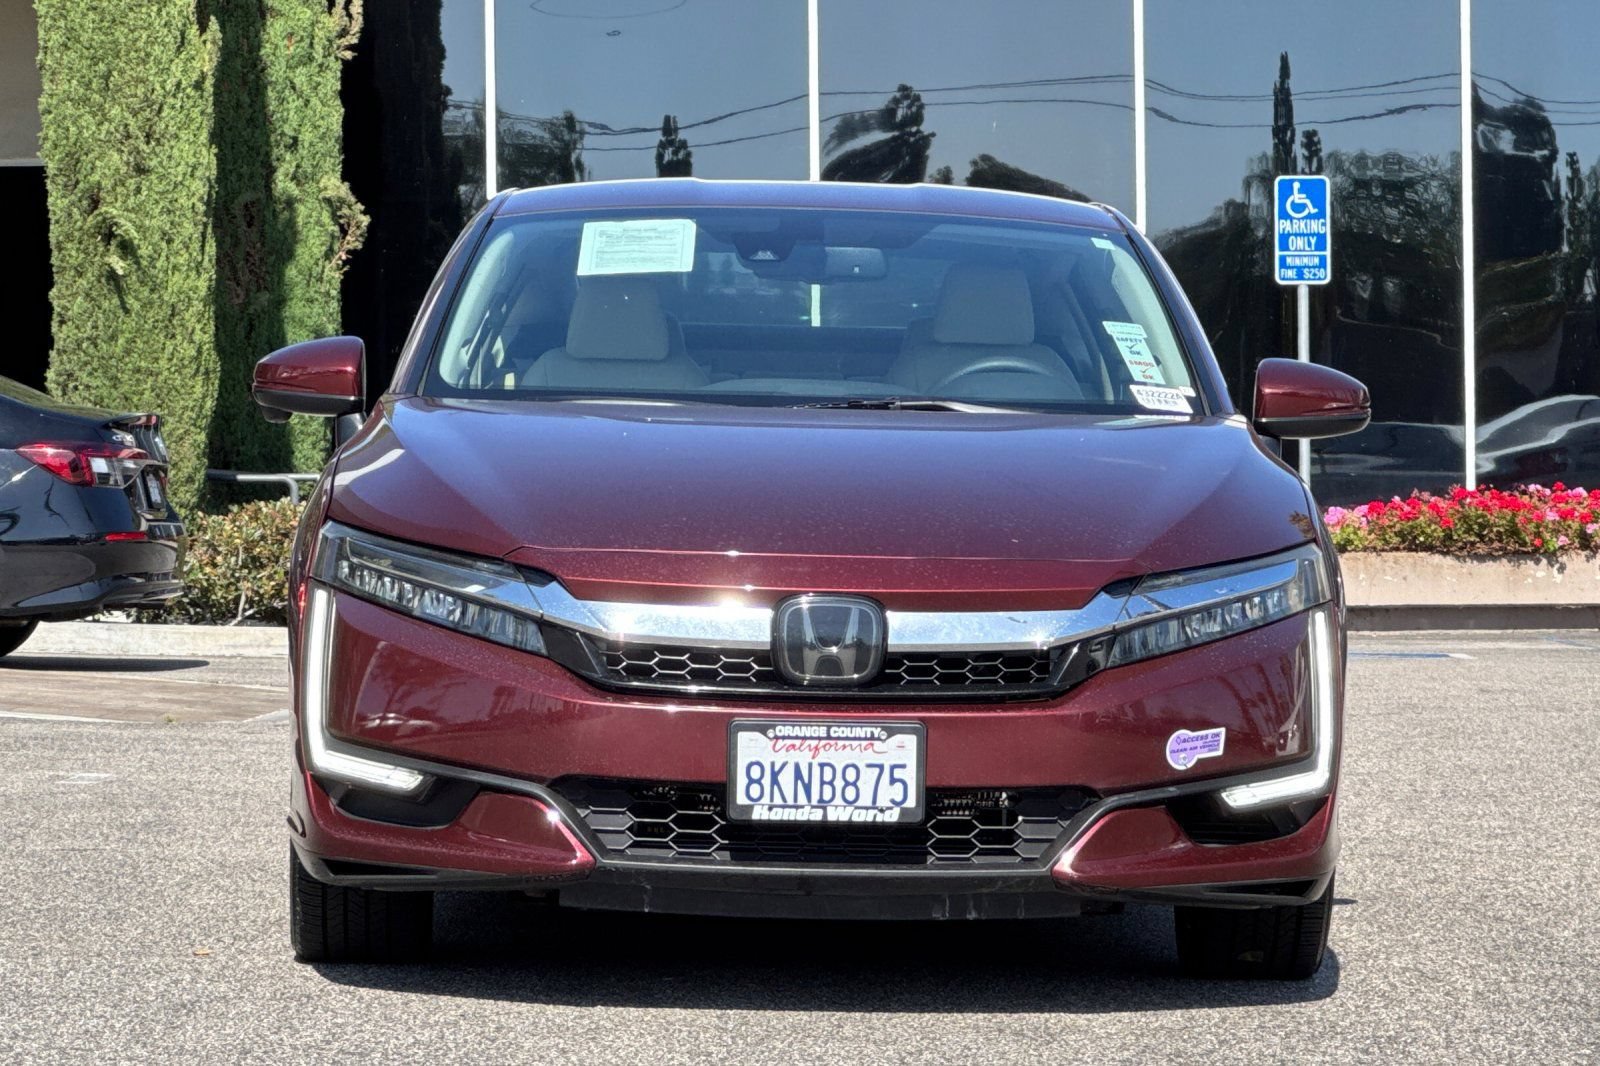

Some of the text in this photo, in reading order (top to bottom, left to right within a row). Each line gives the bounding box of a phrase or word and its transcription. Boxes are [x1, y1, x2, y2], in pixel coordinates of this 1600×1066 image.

[1279, 219, 1326, 234] PARKING
[1288, 236, 1317, 251] ONLY
[1286, 256, 1320, 267] MINIMUM
[1280, 269, 1298, 279] FINE
[775, 726, 881, 738] ORANGE COUNTY
[1182, 734, 1208, 743] ACCESS
[771, 739, 888, 759] California
[745, 760, 909, 807] 8KNB875
[751, 805, 901, 822] Honda World
